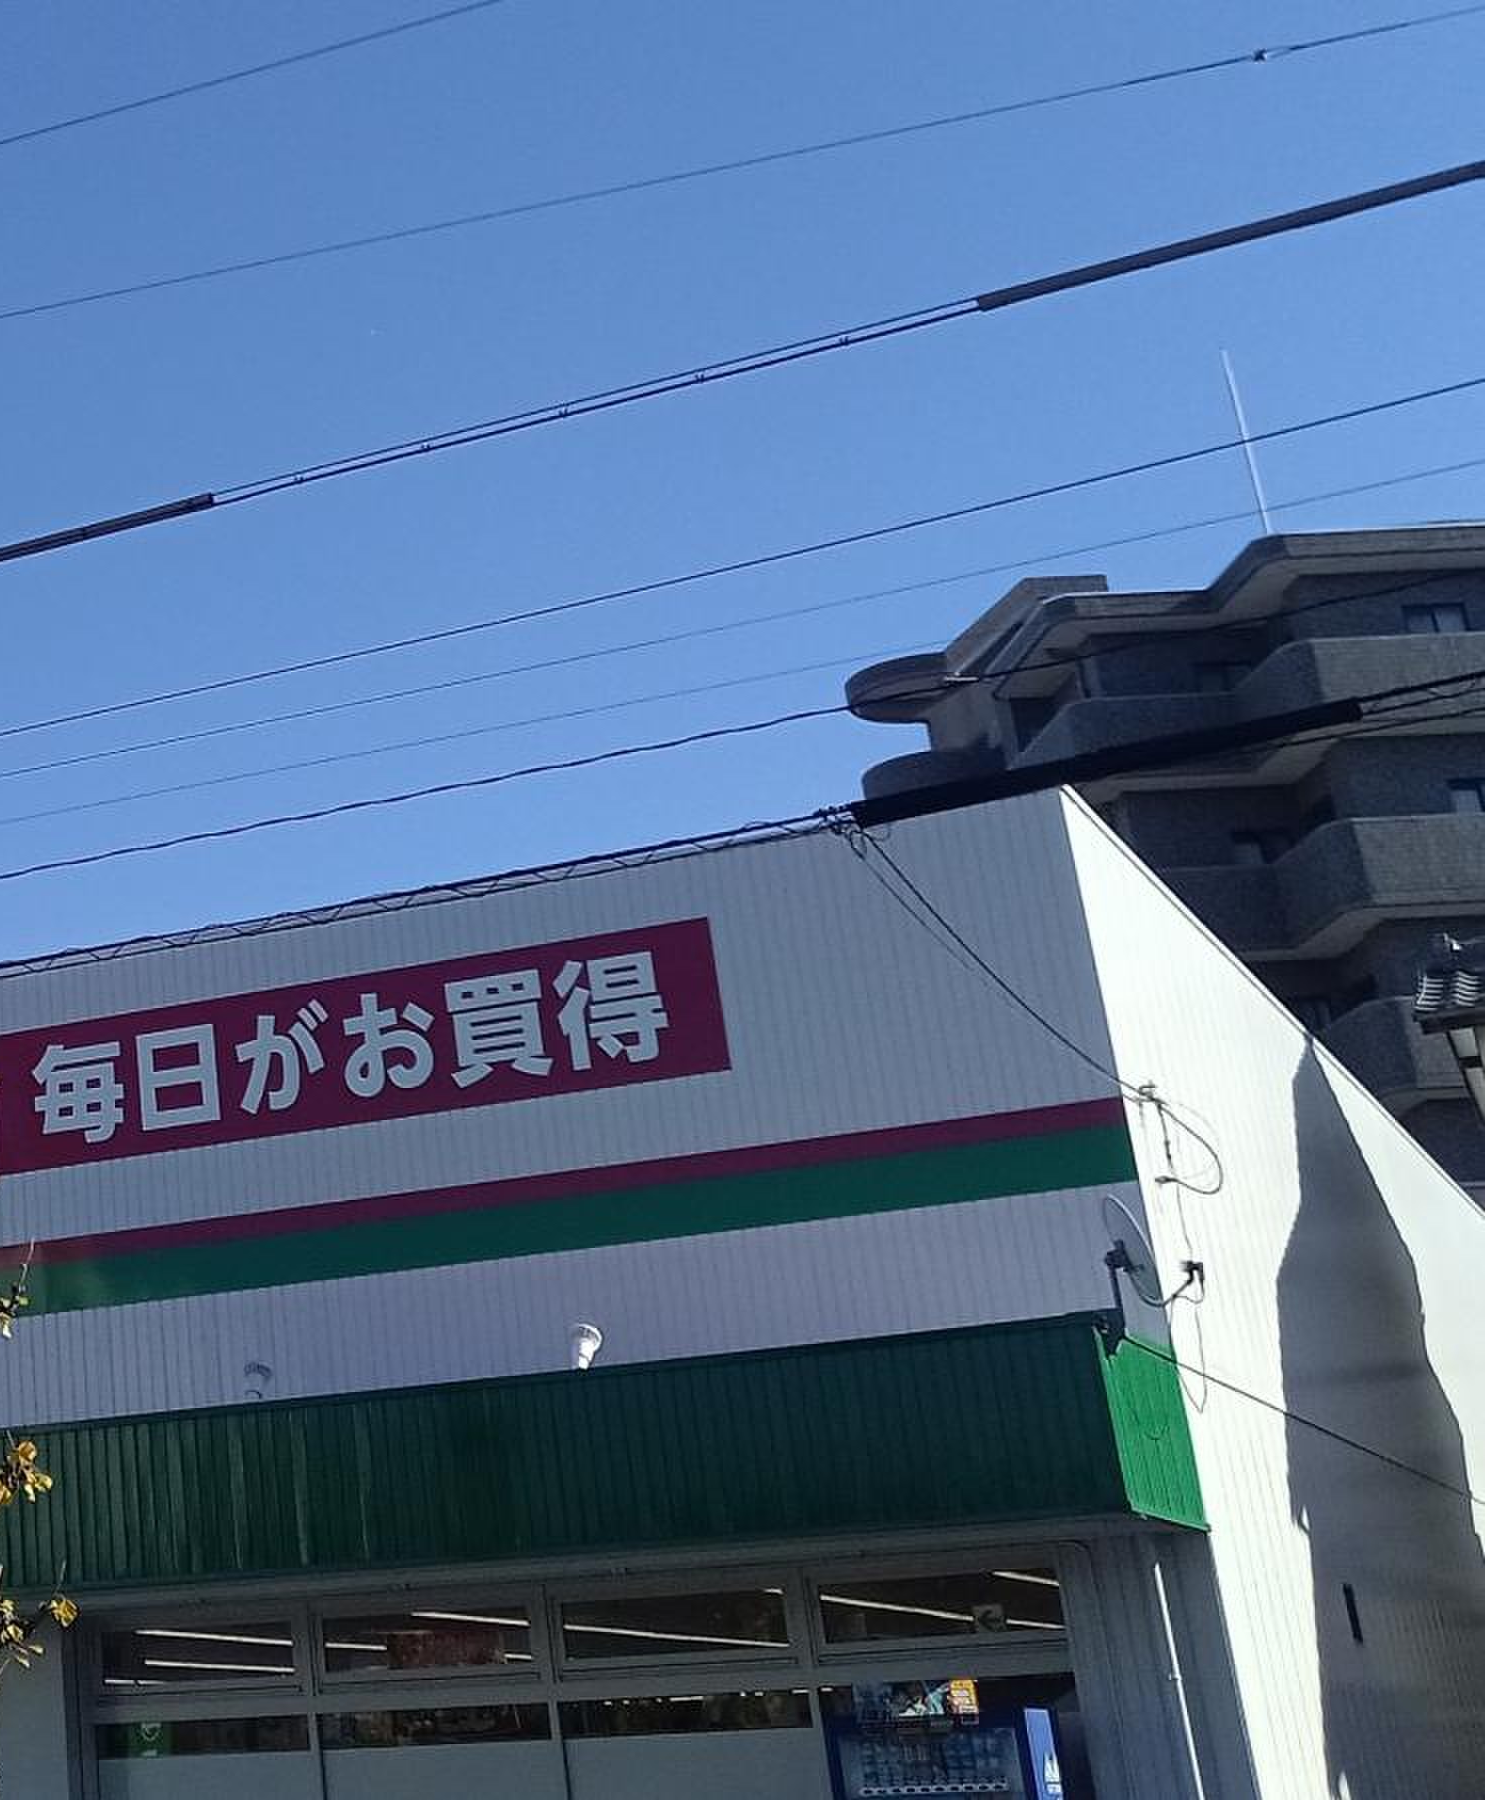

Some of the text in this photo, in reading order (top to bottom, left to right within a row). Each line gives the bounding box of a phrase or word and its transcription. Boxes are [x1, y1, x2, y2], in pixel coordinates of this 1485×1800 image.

[32, 951, 669, 1144] 毎日がお買得
